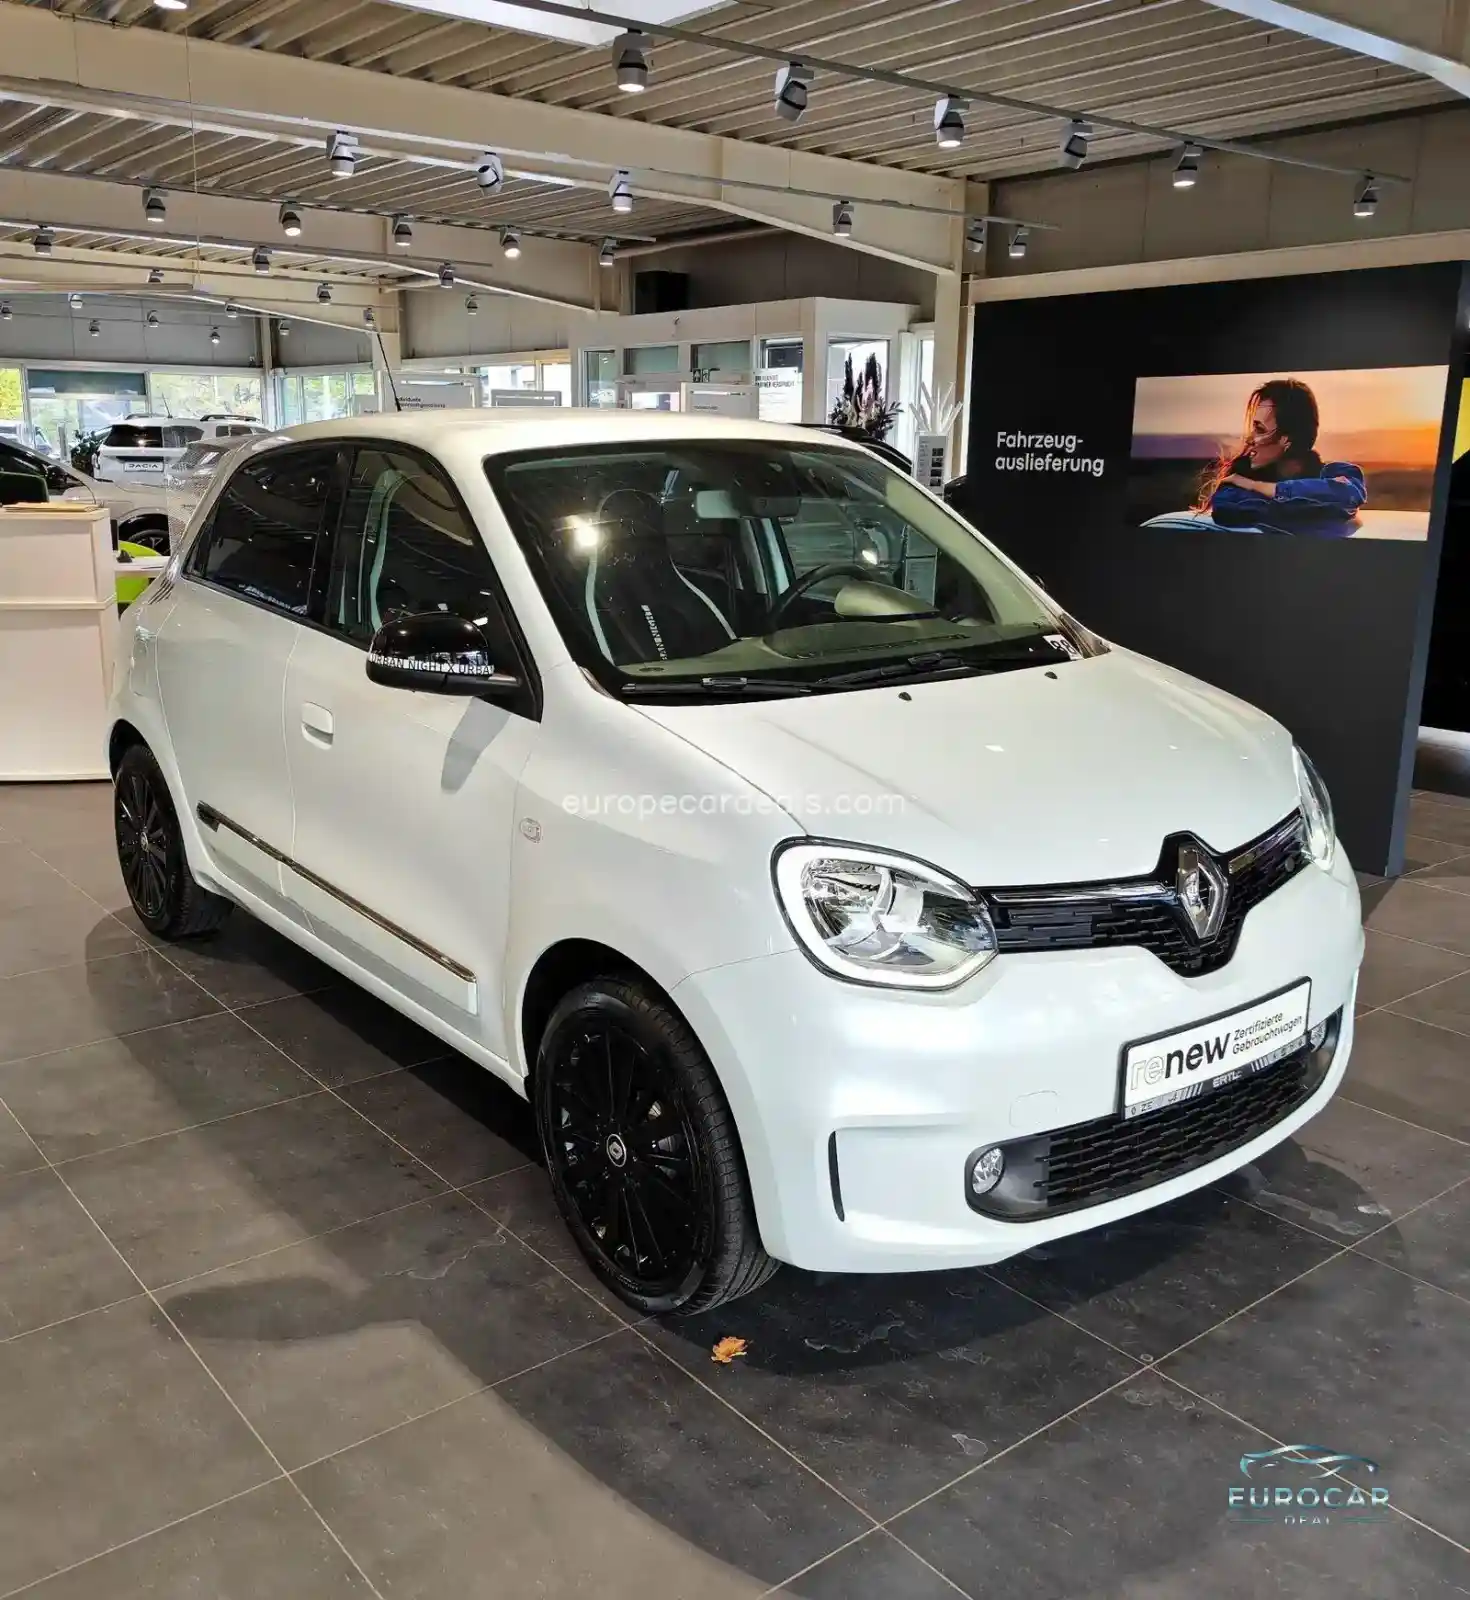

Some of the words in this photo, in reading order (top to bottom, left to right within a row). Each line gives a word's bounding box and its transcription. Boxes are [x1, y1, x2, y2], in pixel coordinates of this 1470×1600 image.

[996, 430, 1084, 453] Fahrzeug-
[995, 453, 1105, 477] auslieferung
[370, 652, 405, 668] URBAN
[407, 656, 445, 672] NIGHT
[1232, 1015, 1303, 1055] Gebrauchtwagen
[1233, 1012, 1284, 1041] Zertifizierte
[1130, 1032, 1231, 1092] renew
